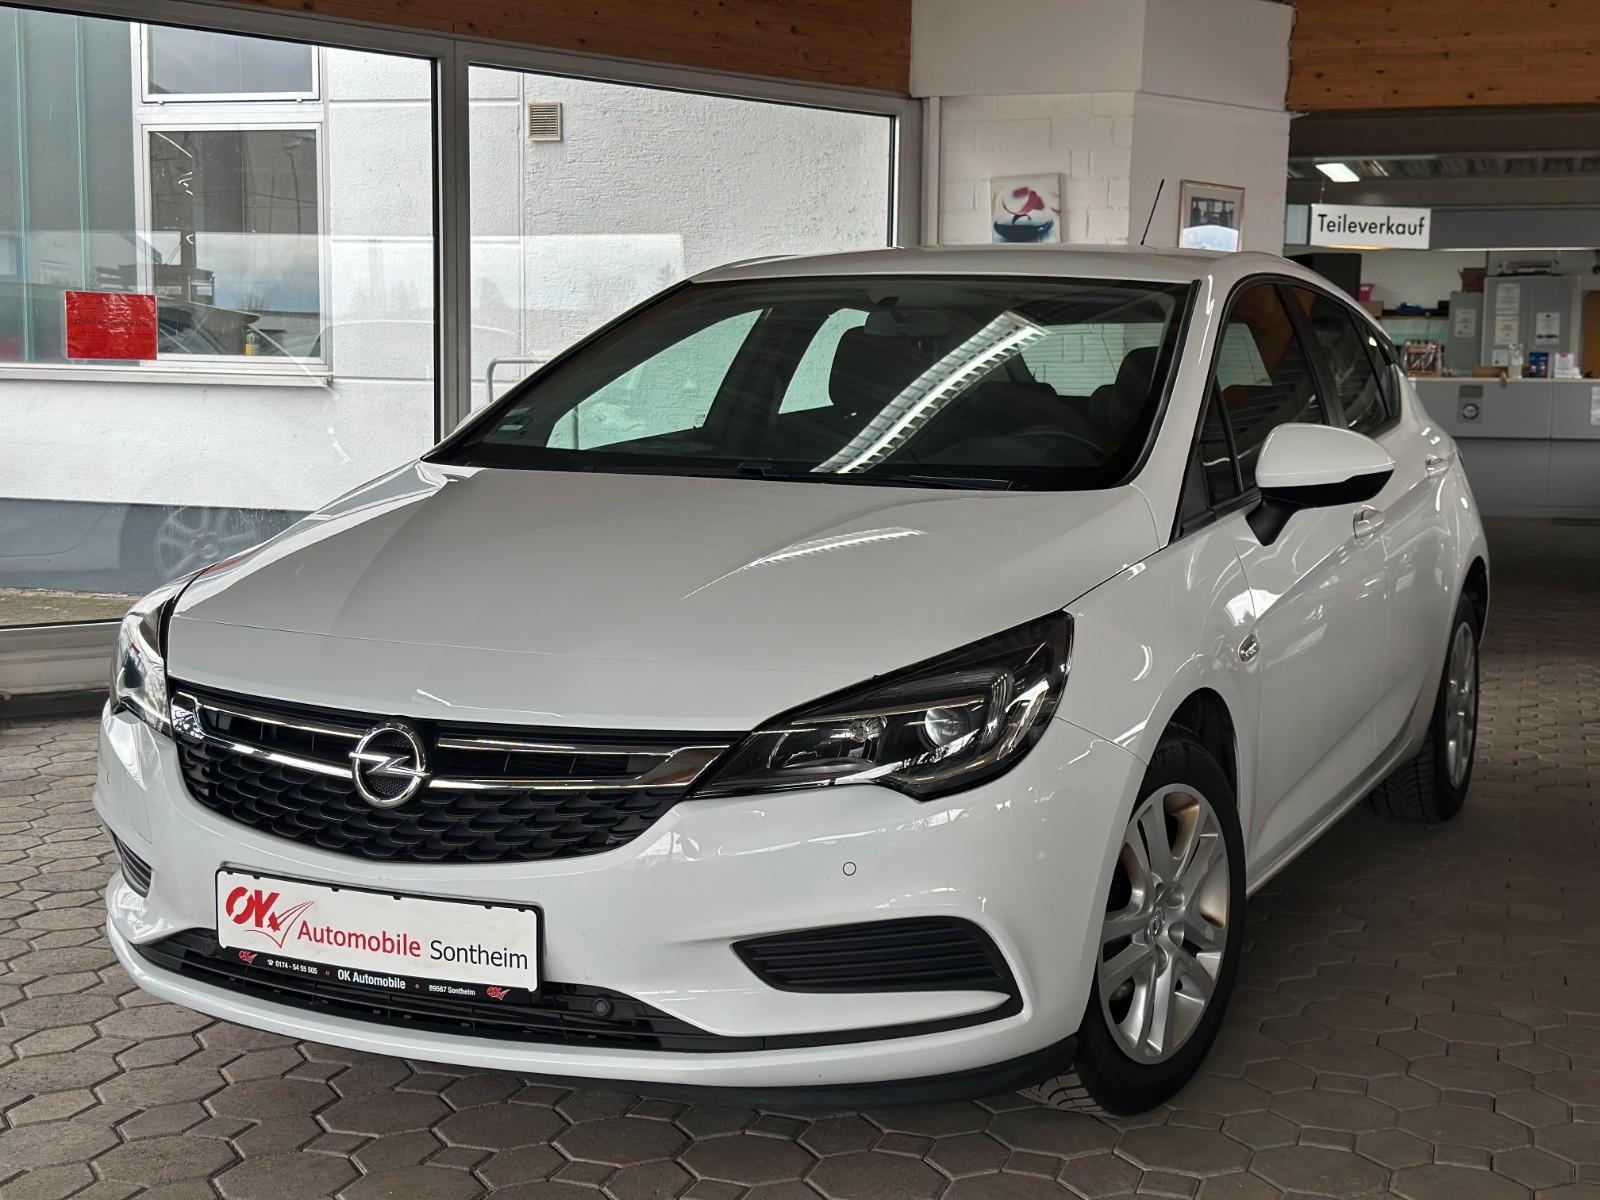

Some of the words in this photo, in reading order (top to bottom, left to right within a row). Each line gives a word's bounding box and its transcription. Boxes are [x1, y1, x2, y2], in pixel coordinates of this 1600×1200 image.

[1317, 213, 1425, 236] Teileverkauf
[226, 886, 281, 932] OK
[297, 919, 421, 958] Automobile
[430, 940, 528, 970] Sontheim
[337, 969, 351, 981] OK
[353, 971, 406, 989] Automobile
[447, 986, 475, 996] Sontheim
